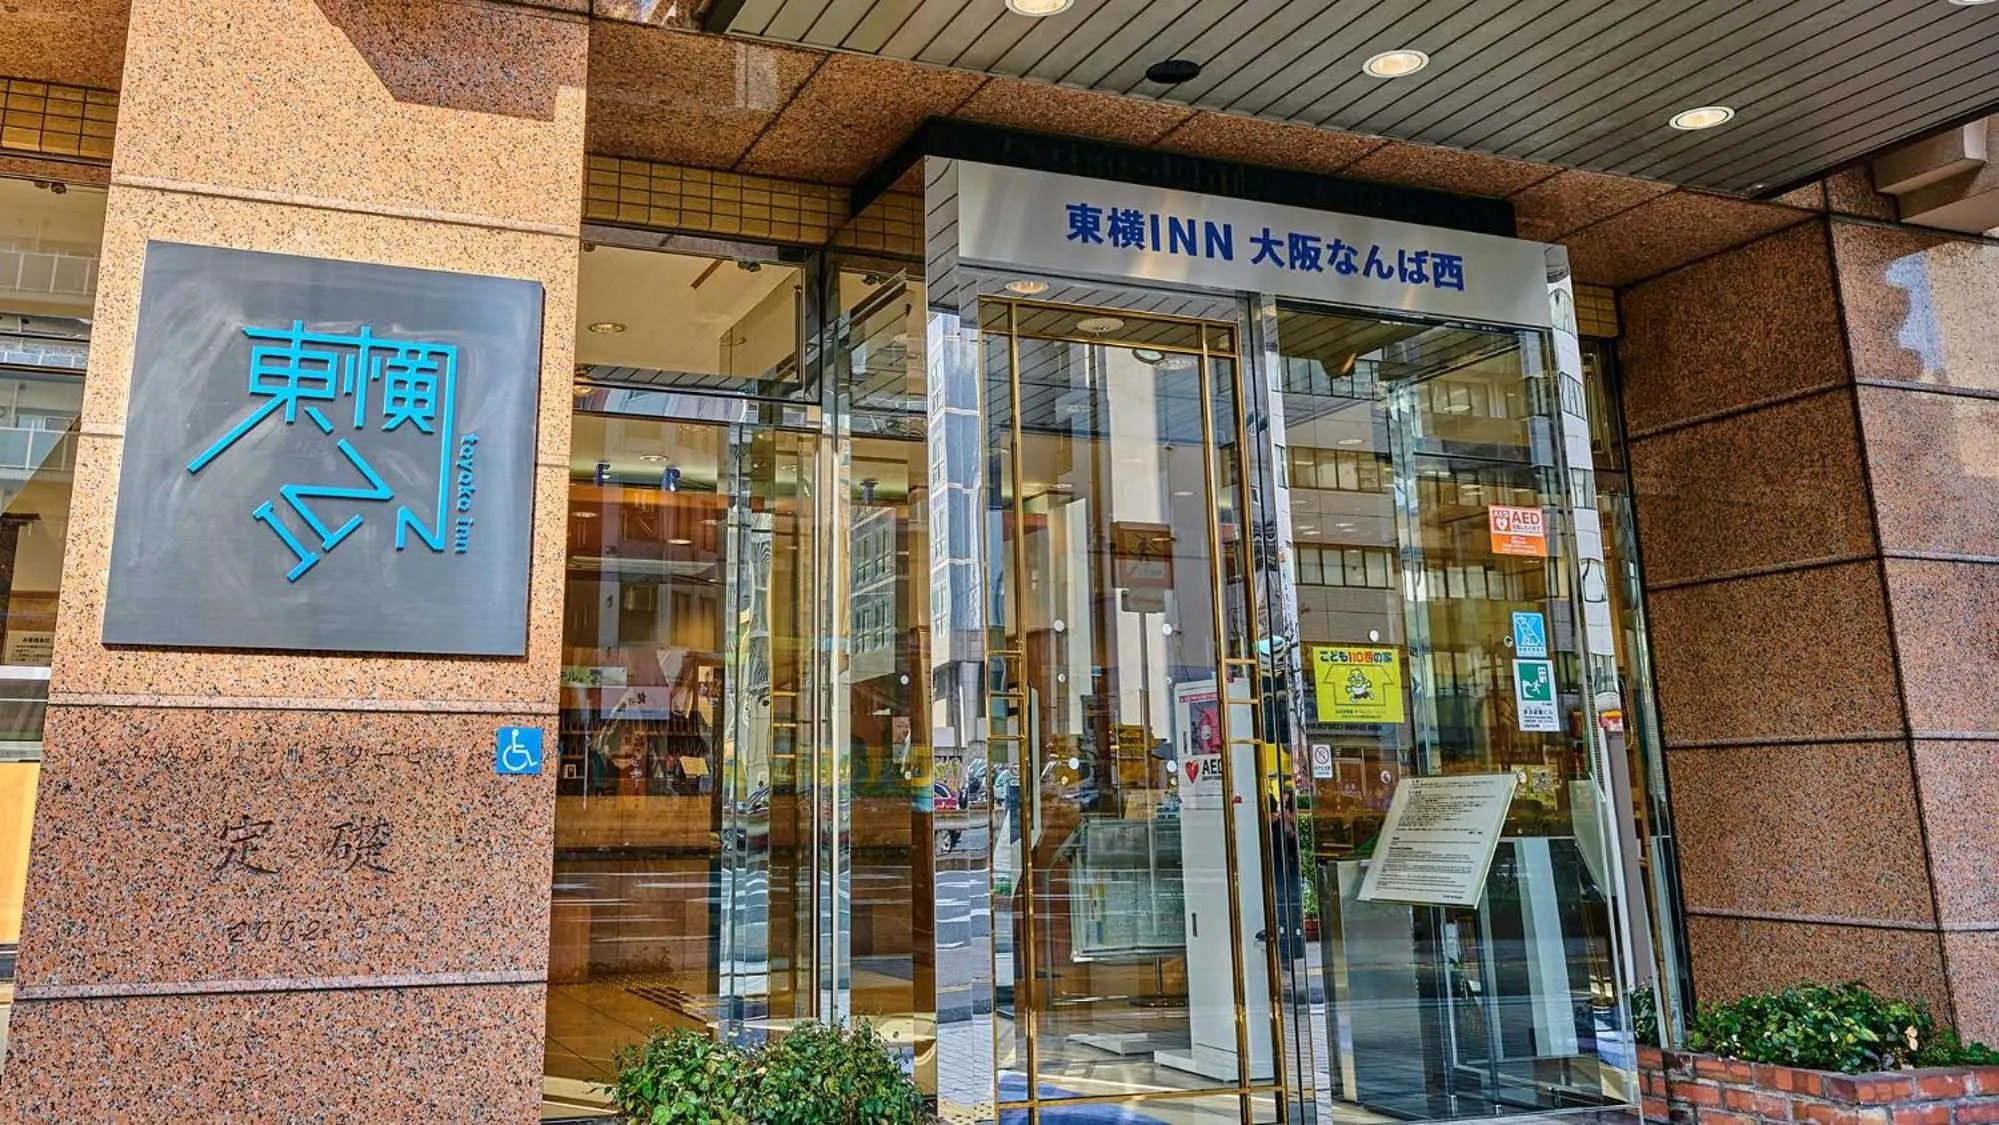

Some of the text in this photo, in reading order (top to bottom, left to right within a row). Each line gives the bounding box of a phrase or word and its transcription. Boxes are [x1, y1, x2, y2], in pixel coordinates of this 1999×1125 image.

[1065, 203, 1466, 292] 東横INN 大阪なんば西
[455, 433, 479, 554] toyoko inn
[1512, 511, 1540, 525] AED
